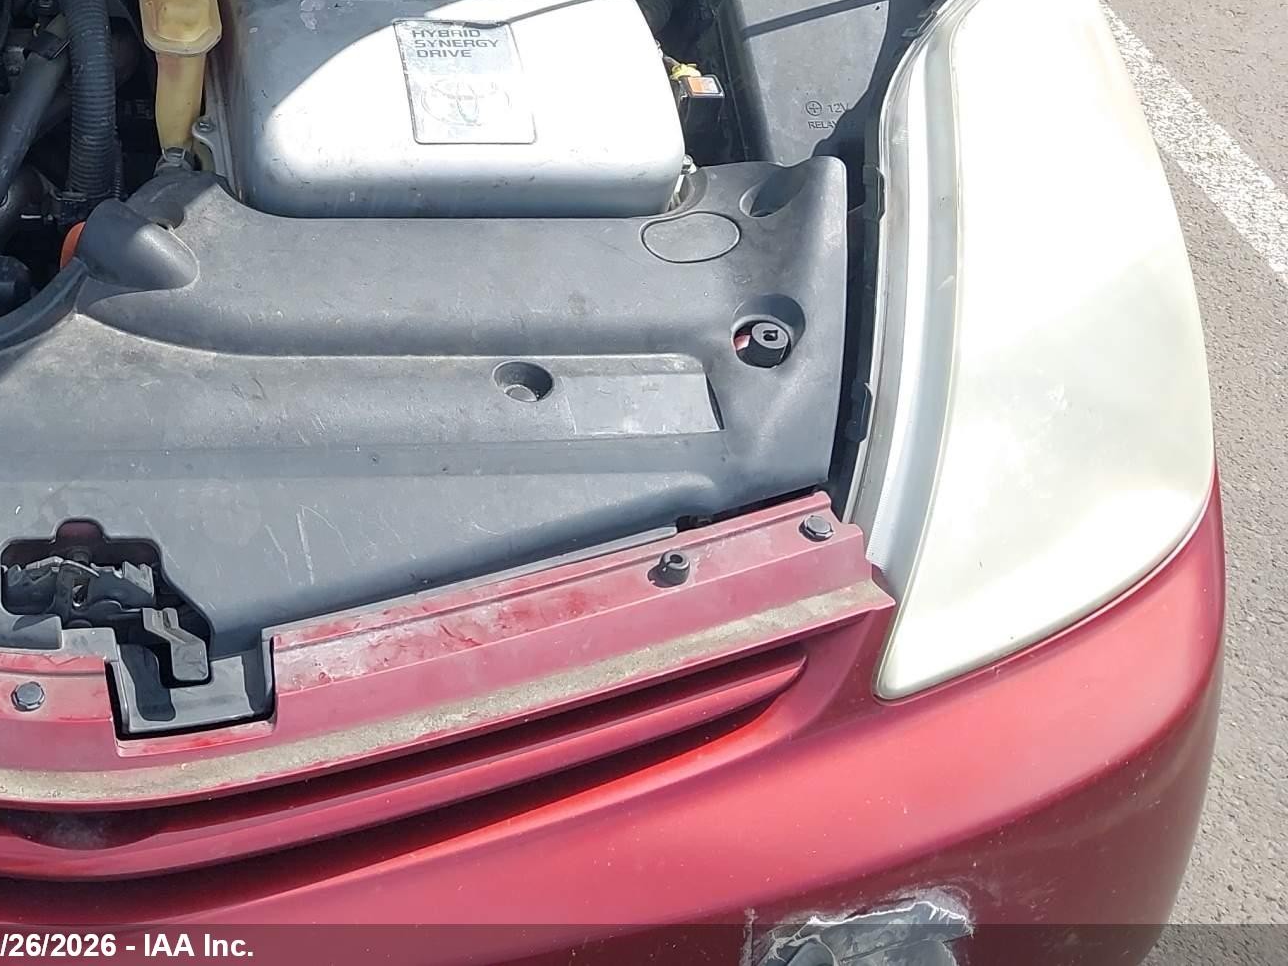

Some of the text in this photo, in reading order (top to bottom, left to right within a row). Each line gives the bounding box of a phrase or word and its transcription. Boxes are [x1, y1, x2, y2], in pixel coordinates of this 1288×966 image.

[412, 29, 481, 38] HYBRID
[414, 39, 498, 48] SYNERGY
[416, 49, 472, 58] DRIVE
